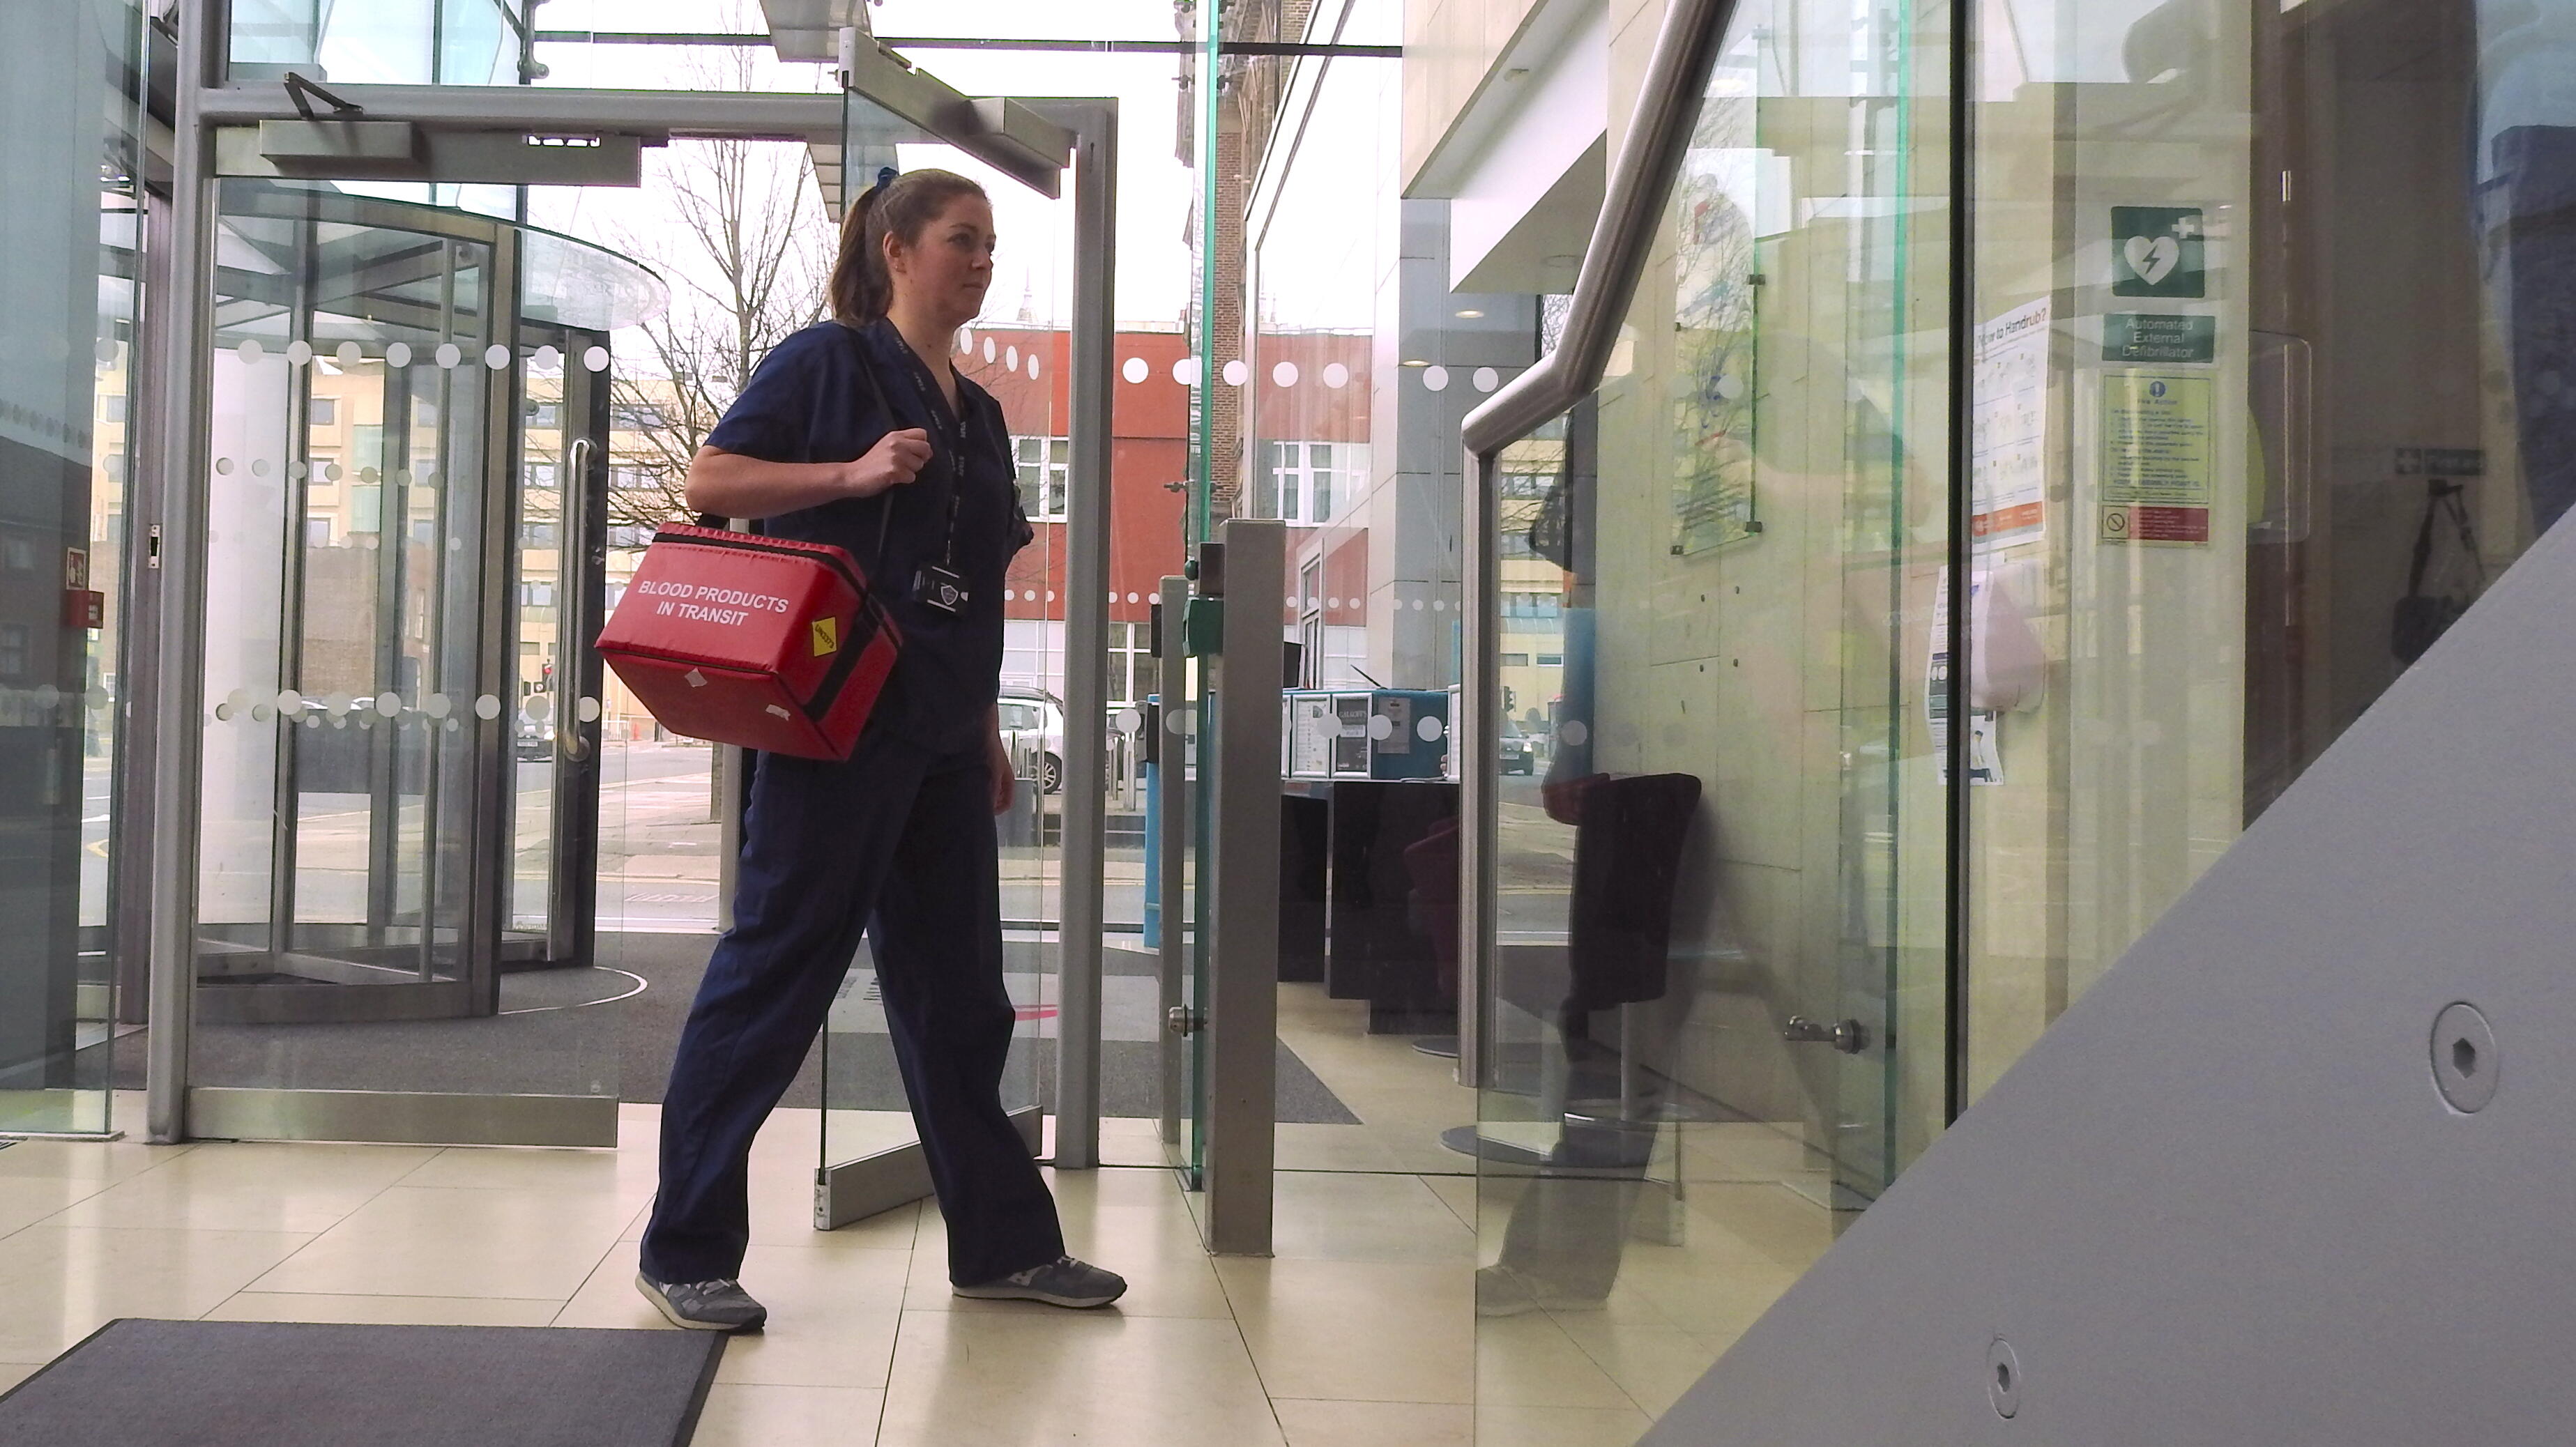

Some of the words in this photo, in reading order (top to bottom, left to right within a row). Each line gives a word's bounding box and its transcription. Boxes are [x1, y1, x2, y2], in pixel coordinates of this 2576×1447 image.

[1996, 327, 2004, 340] to
[2004, 307, 2046, 335] Handrub?
[2126, 318, 2193, 330] Automated
[2133, 331, 2185, 344] External
[2122, 344, 2194, 358] Defibrillator
[638, 580, 693, 598] BLOOD
[695, 585, 789, 613] PRODUCTS
[656, 601, 676, 615] IN
[678, 603, 749, 626] TRANSIT
[815, 624, 834, 649] UN3373
